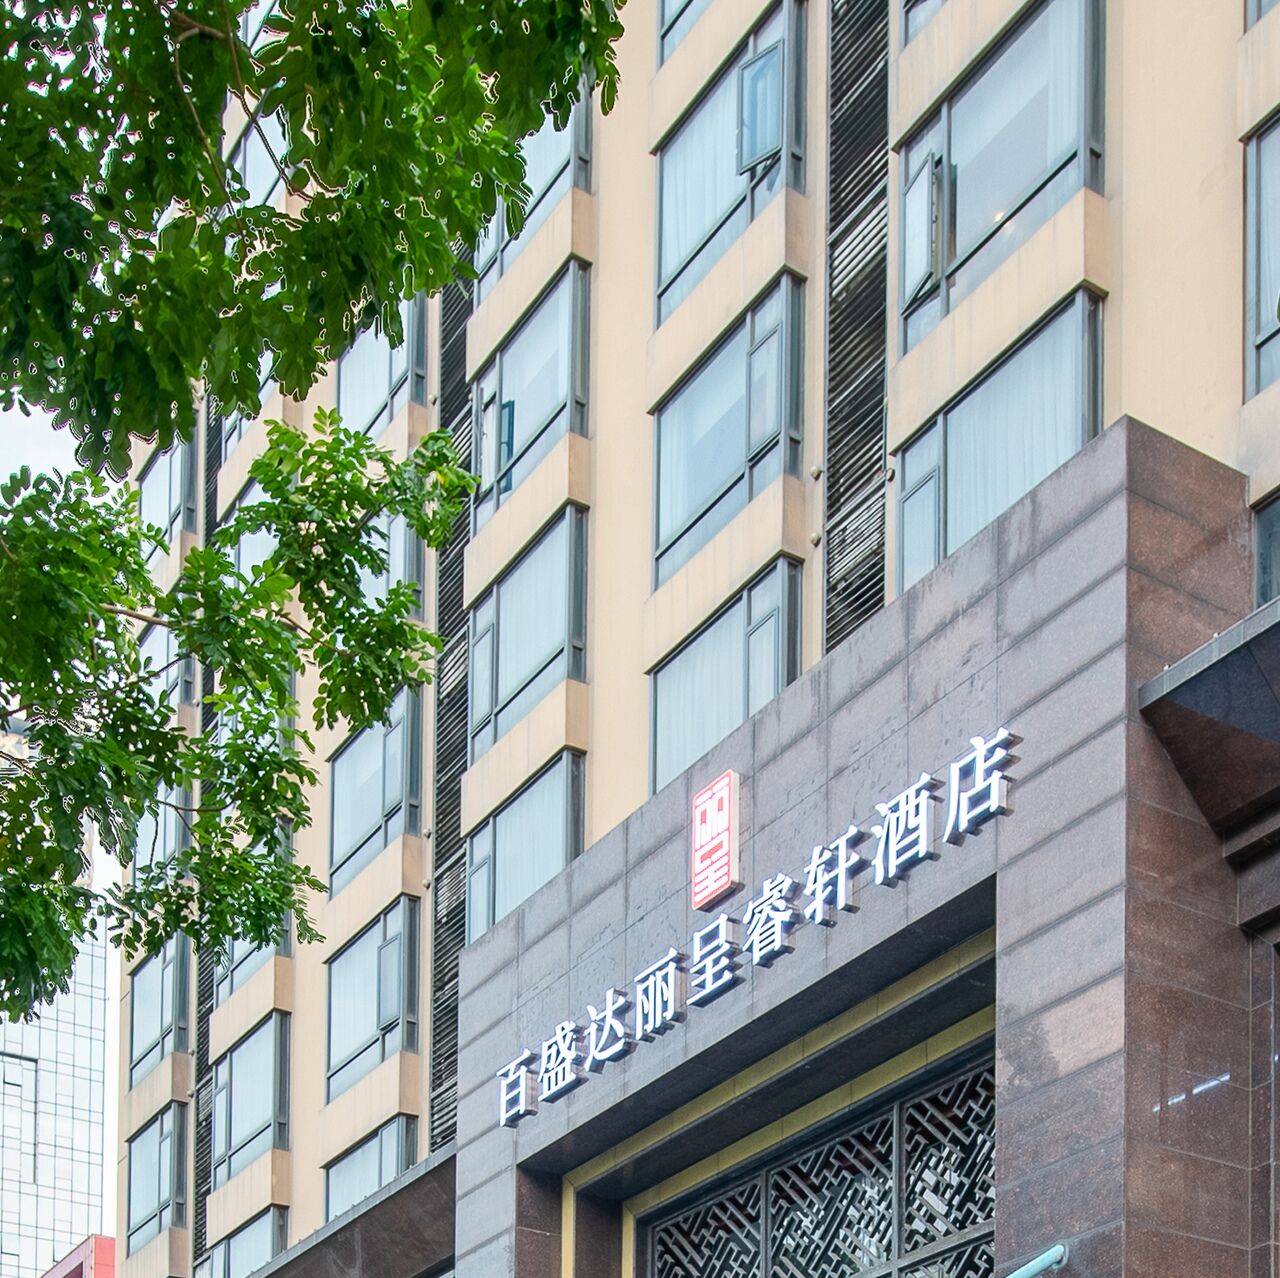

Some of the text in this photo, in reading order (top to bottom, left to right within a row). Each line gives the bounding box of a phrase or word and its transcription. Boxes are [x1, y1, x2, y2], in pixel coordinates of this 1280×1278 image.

[495, 727, 1014, 1128] 百盛达丽呈睿轩酒店
